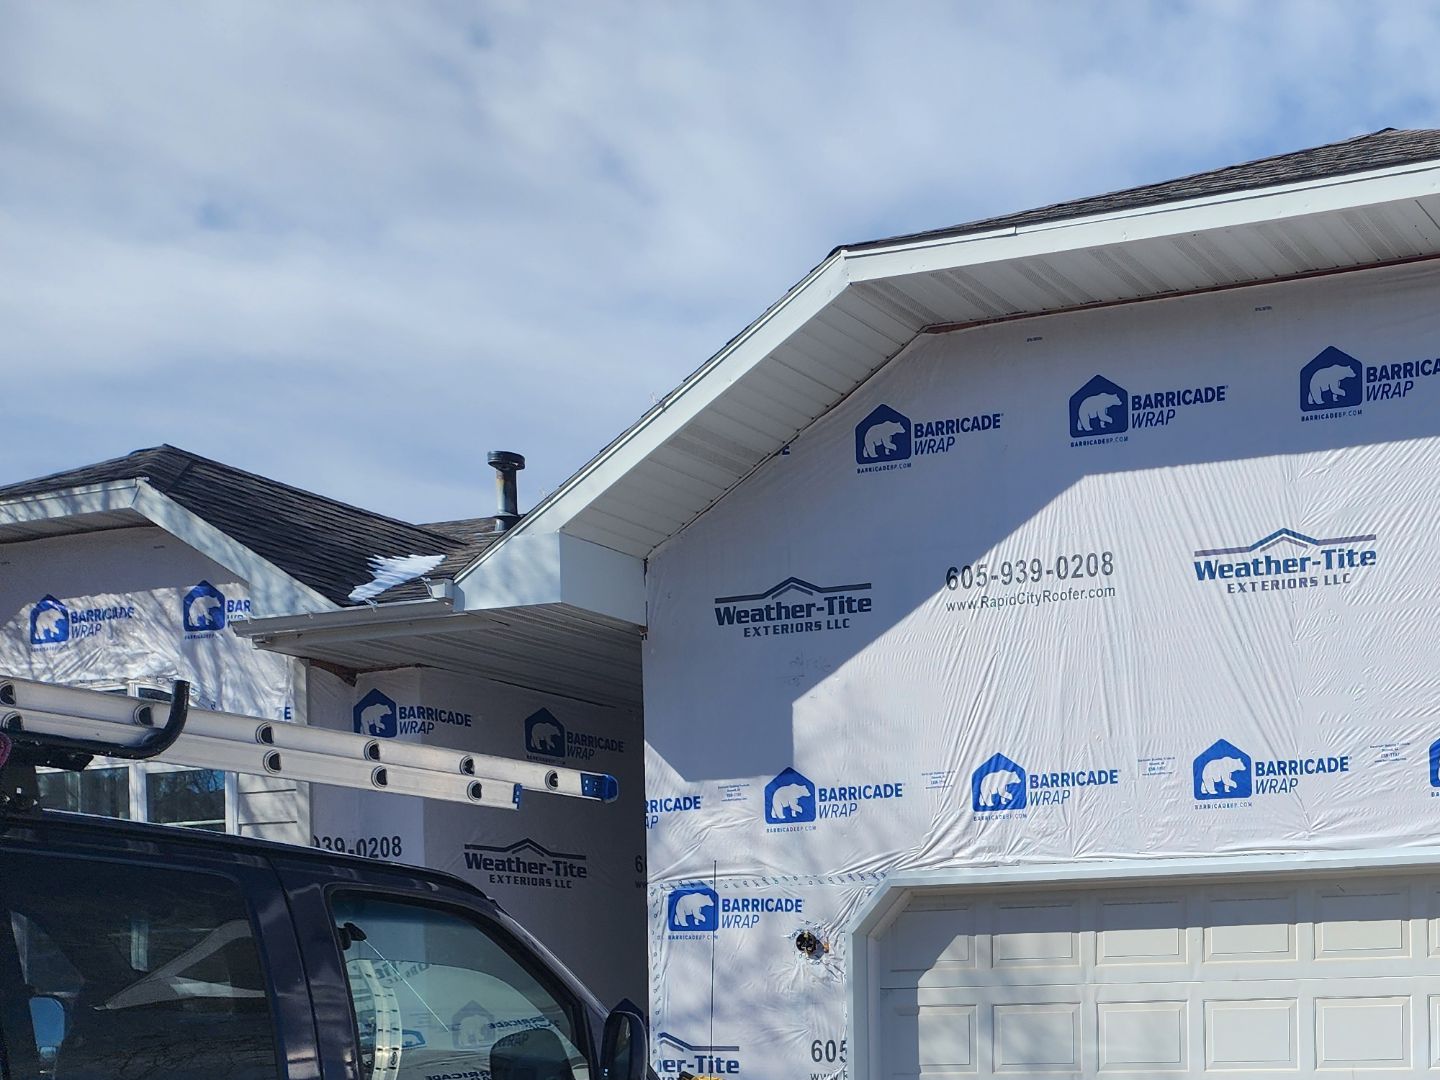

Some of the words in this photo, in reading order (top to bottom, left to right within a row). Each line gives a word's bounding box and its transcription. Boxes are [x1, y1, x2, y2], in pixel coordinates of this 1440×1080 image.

[1131, 387, 1226, 411] BARRICADE
[1365, 381, 1414, 401] WRAP
[914, 414, 1001, 438] BARRICADE
[1131, 410, 1176, 430] WRAP
[913, 437, 955, 455] WRAP
[946, 551, 1114, 591] 605-939-0208
[1194, 548, 1377, 581] Weather-Tite
[1227, 575, 1319, 595] EXTERIORS
[1324, 572, 1351, 587] LLC
[946, 584, 1116, 612] www.RapidCityRoofer.com
[715, 595, 872, 627] Weather-Tite
[70, 624, 102, 638] WRAP
[744, 621, 822, 638] EXTERIORS
[827, 618, 850, 631] LLC
[399, 706, 472, 727] BARRICADE
[399, 720, 435, 735] WRAP
[566, 731, 624, 753] BARRICADE
[566, 746, 595, 760] WRAP
[1255, 756, 1349, 778] BARRICADE
[1029, 769, 1118, 789] BARRICADE
[1255, 778, 1299, 795] WRAP
[818, 783, 903, 803] BARRICADE
[1029, 790, 1070, 806] WRAP
[818, 802, 858, 819] WRAP
[464, 852, 587, 878] Weather-Tite
[489, 874, 551, 888] EXTERIORS
[554, 877, 573, 889] LLC
[722, 898, 803, 912] BARRICADE
[721, 915, 760, 929] WRAP
